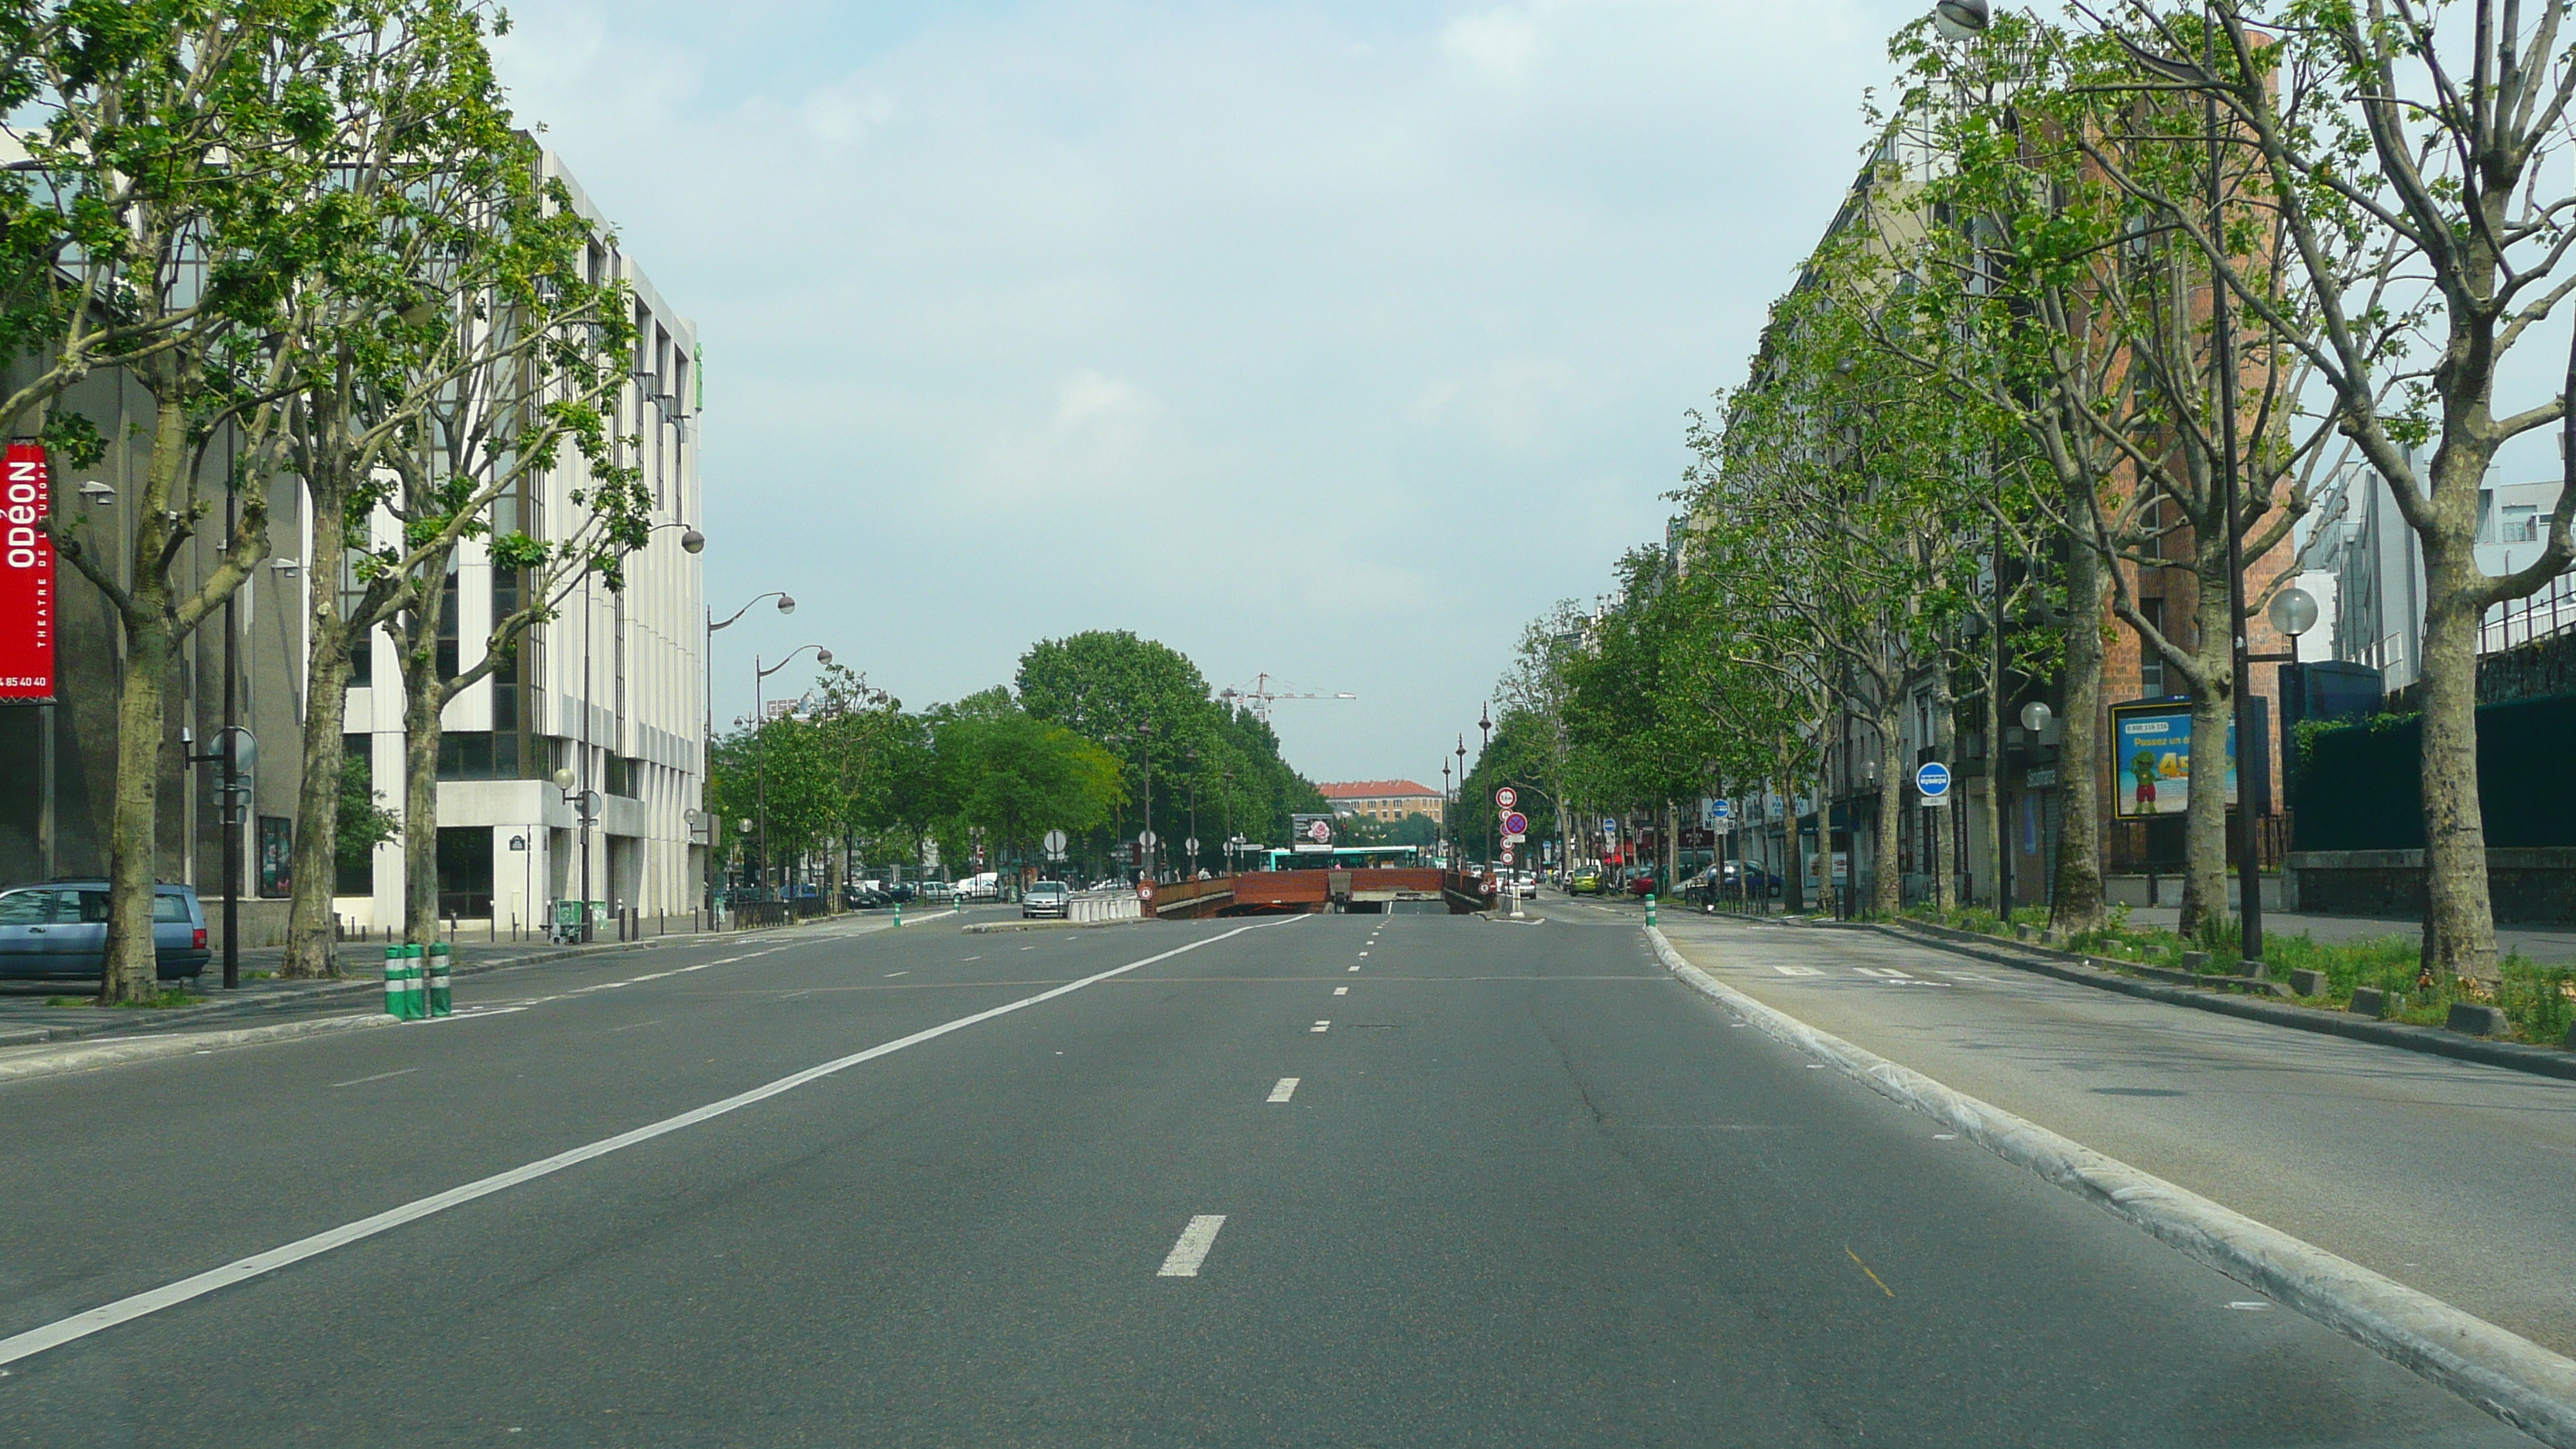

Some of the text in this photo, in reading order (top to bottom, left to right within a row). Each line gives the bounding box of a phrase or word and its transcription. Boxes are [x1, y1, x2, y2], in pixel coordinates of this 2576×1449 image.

[38, 550, 47, 567] DE
[37, 578, 47, 648] THEATRE
[6, 677, 18, 687] 85
[19, 677, 32, 687] 40
[33, 677, 46, 687] 40
